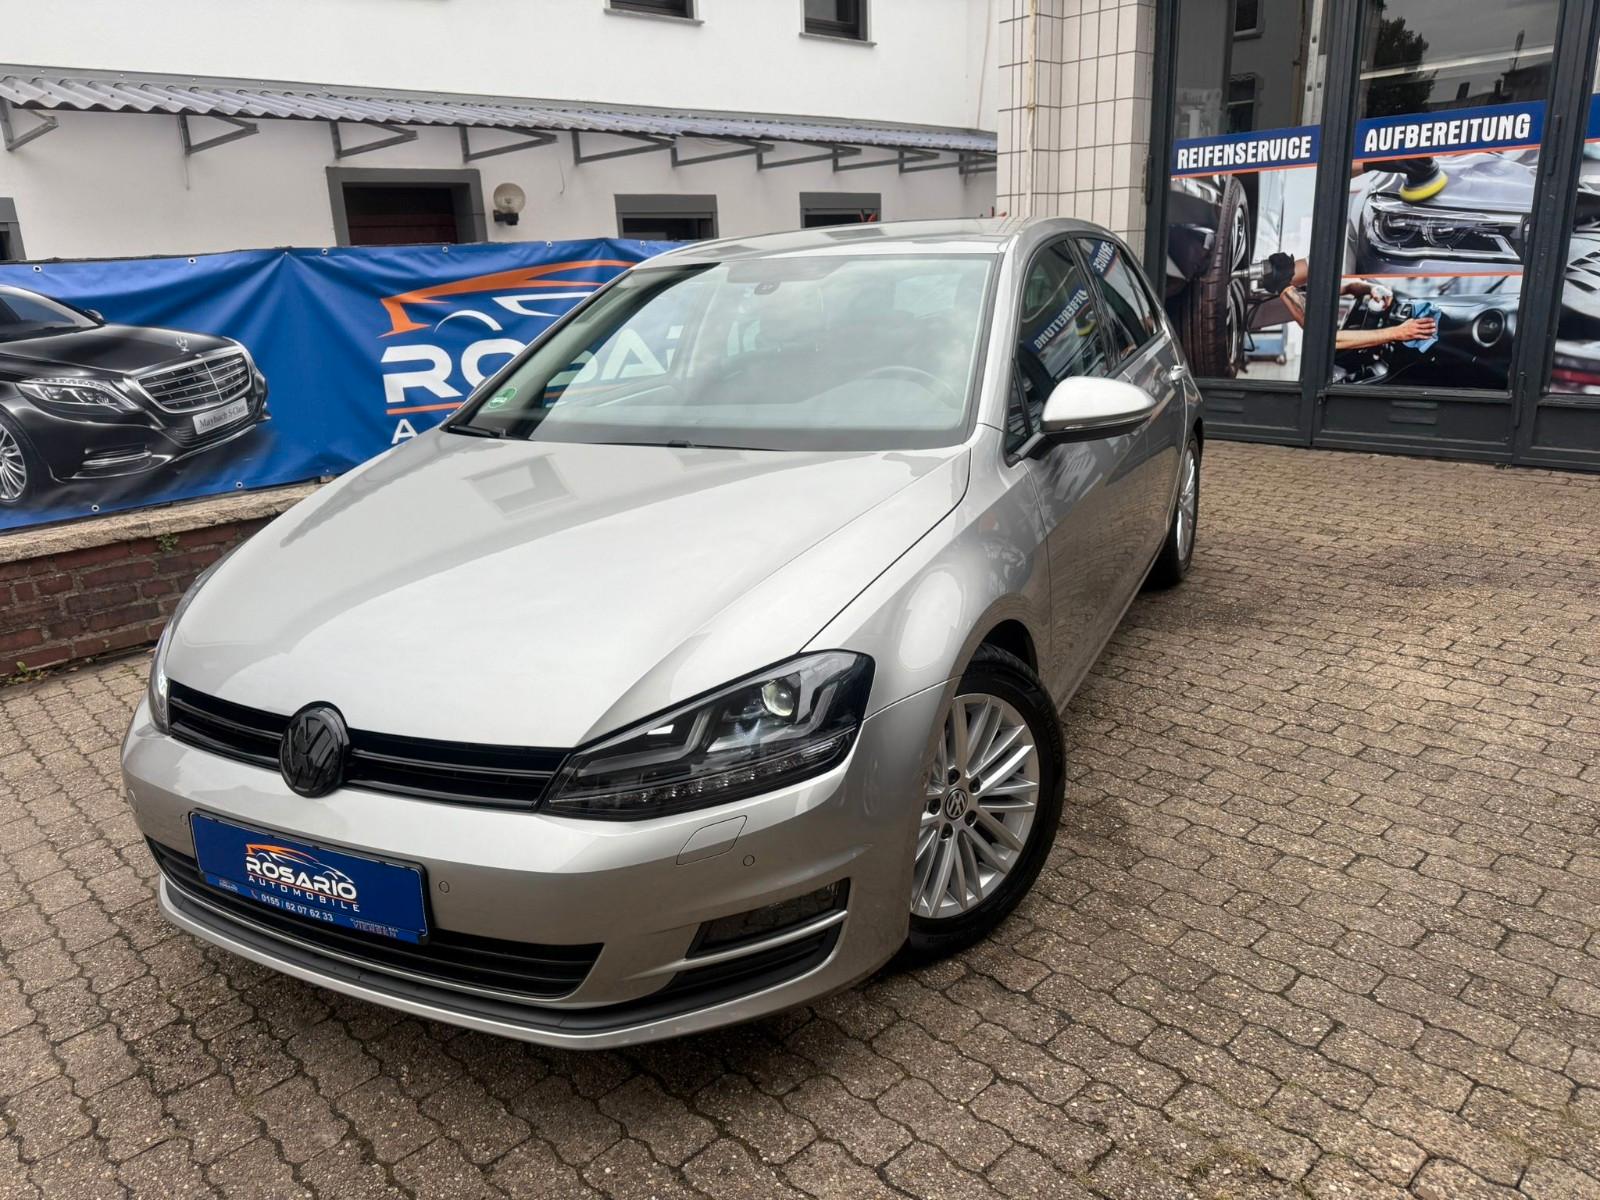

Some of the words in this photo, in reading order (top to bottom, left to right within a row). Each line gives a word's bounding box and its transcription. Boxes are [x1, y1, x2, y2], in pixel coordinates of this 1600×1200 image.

[1364, 113, 1532, 152] AUFBEREITUNG
[1177, 136, 1312, 169] REIFENSERVICE
[246, 856, 357, 900] ROSARIO
[248, 875, 360, 912] AUTOMOBILE
[261, 894, 280, 906] 0155
[298, 905, 307, 915] 07
